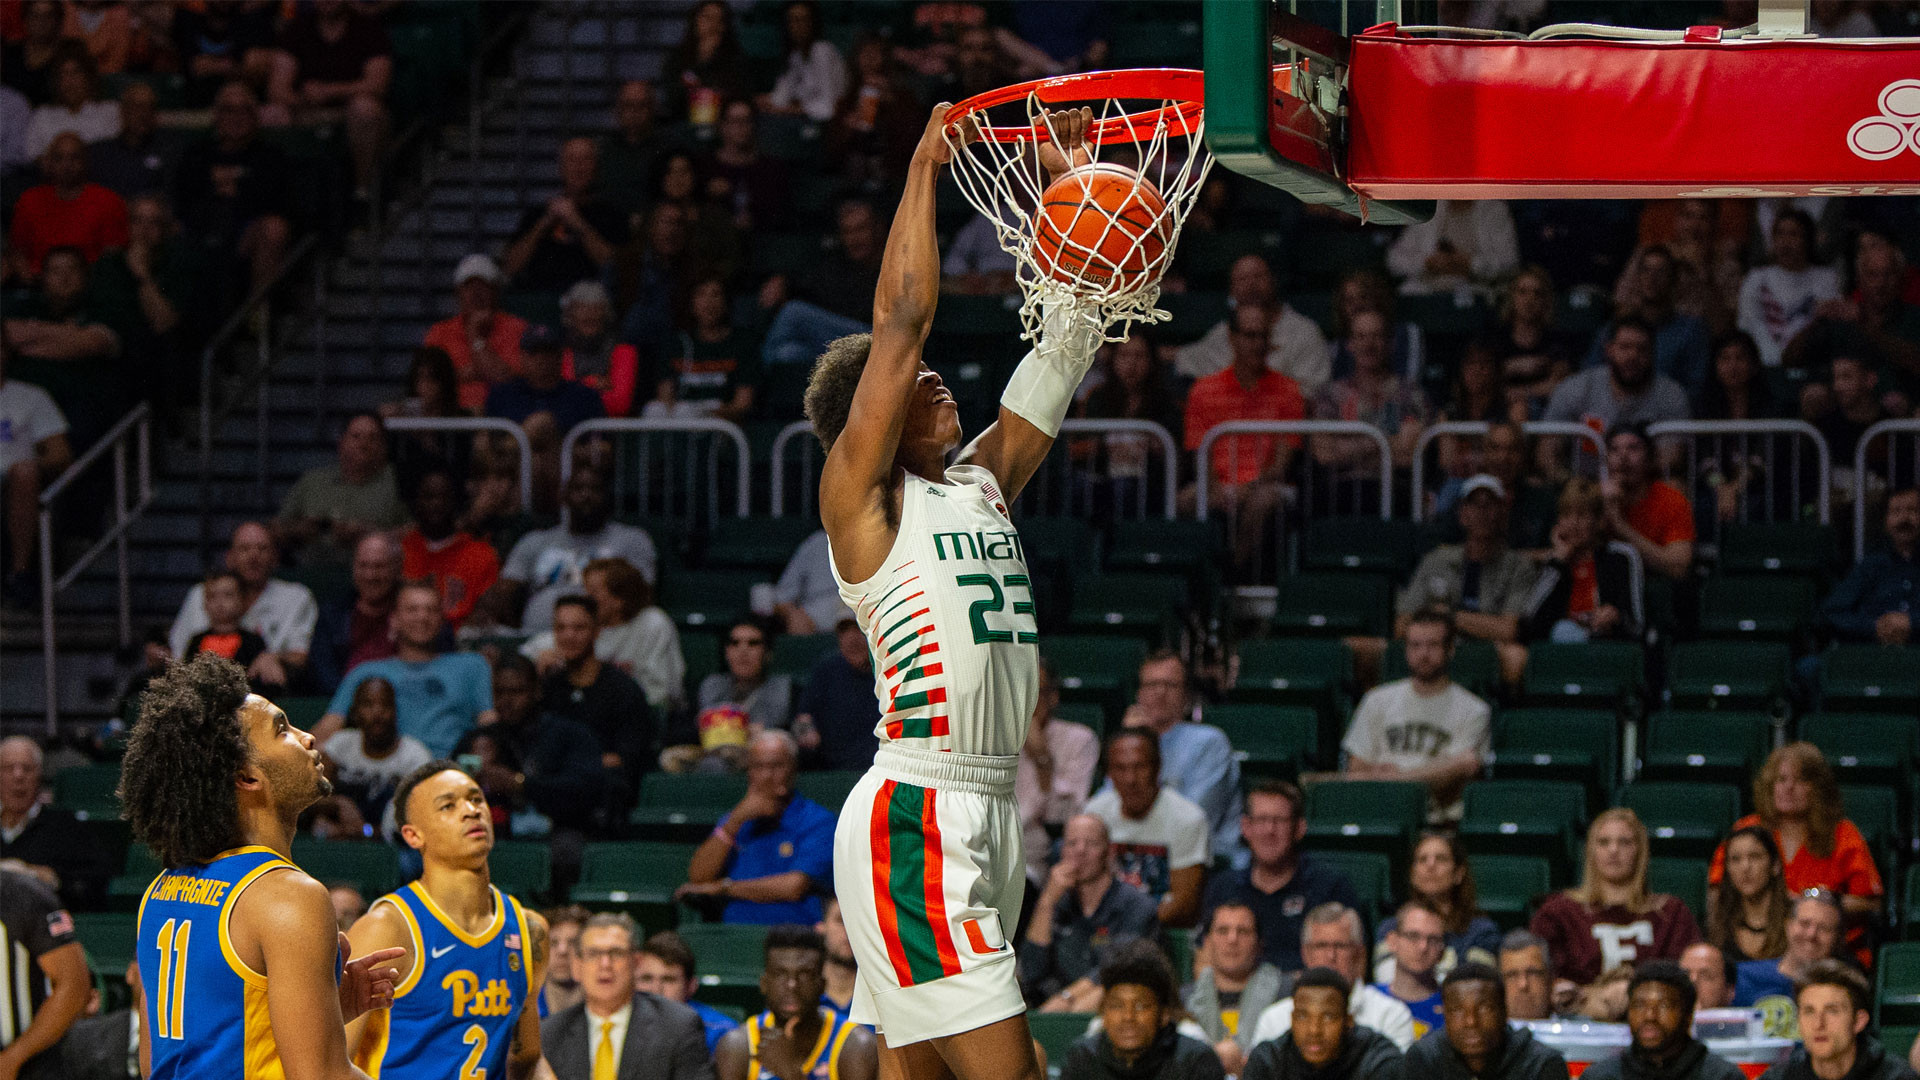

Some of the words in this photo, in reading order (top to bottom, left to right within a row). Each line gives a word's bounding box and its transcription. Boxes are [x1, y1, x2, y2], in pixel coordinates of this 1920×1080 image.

[956, 573, 1039, 645] 23
[1591, 921, 1653, 974] F
[156, 918, 192, 1040] 11
[442, 969, 512, 1017] Pitt
[459, 1024, 488, 1080] 2
